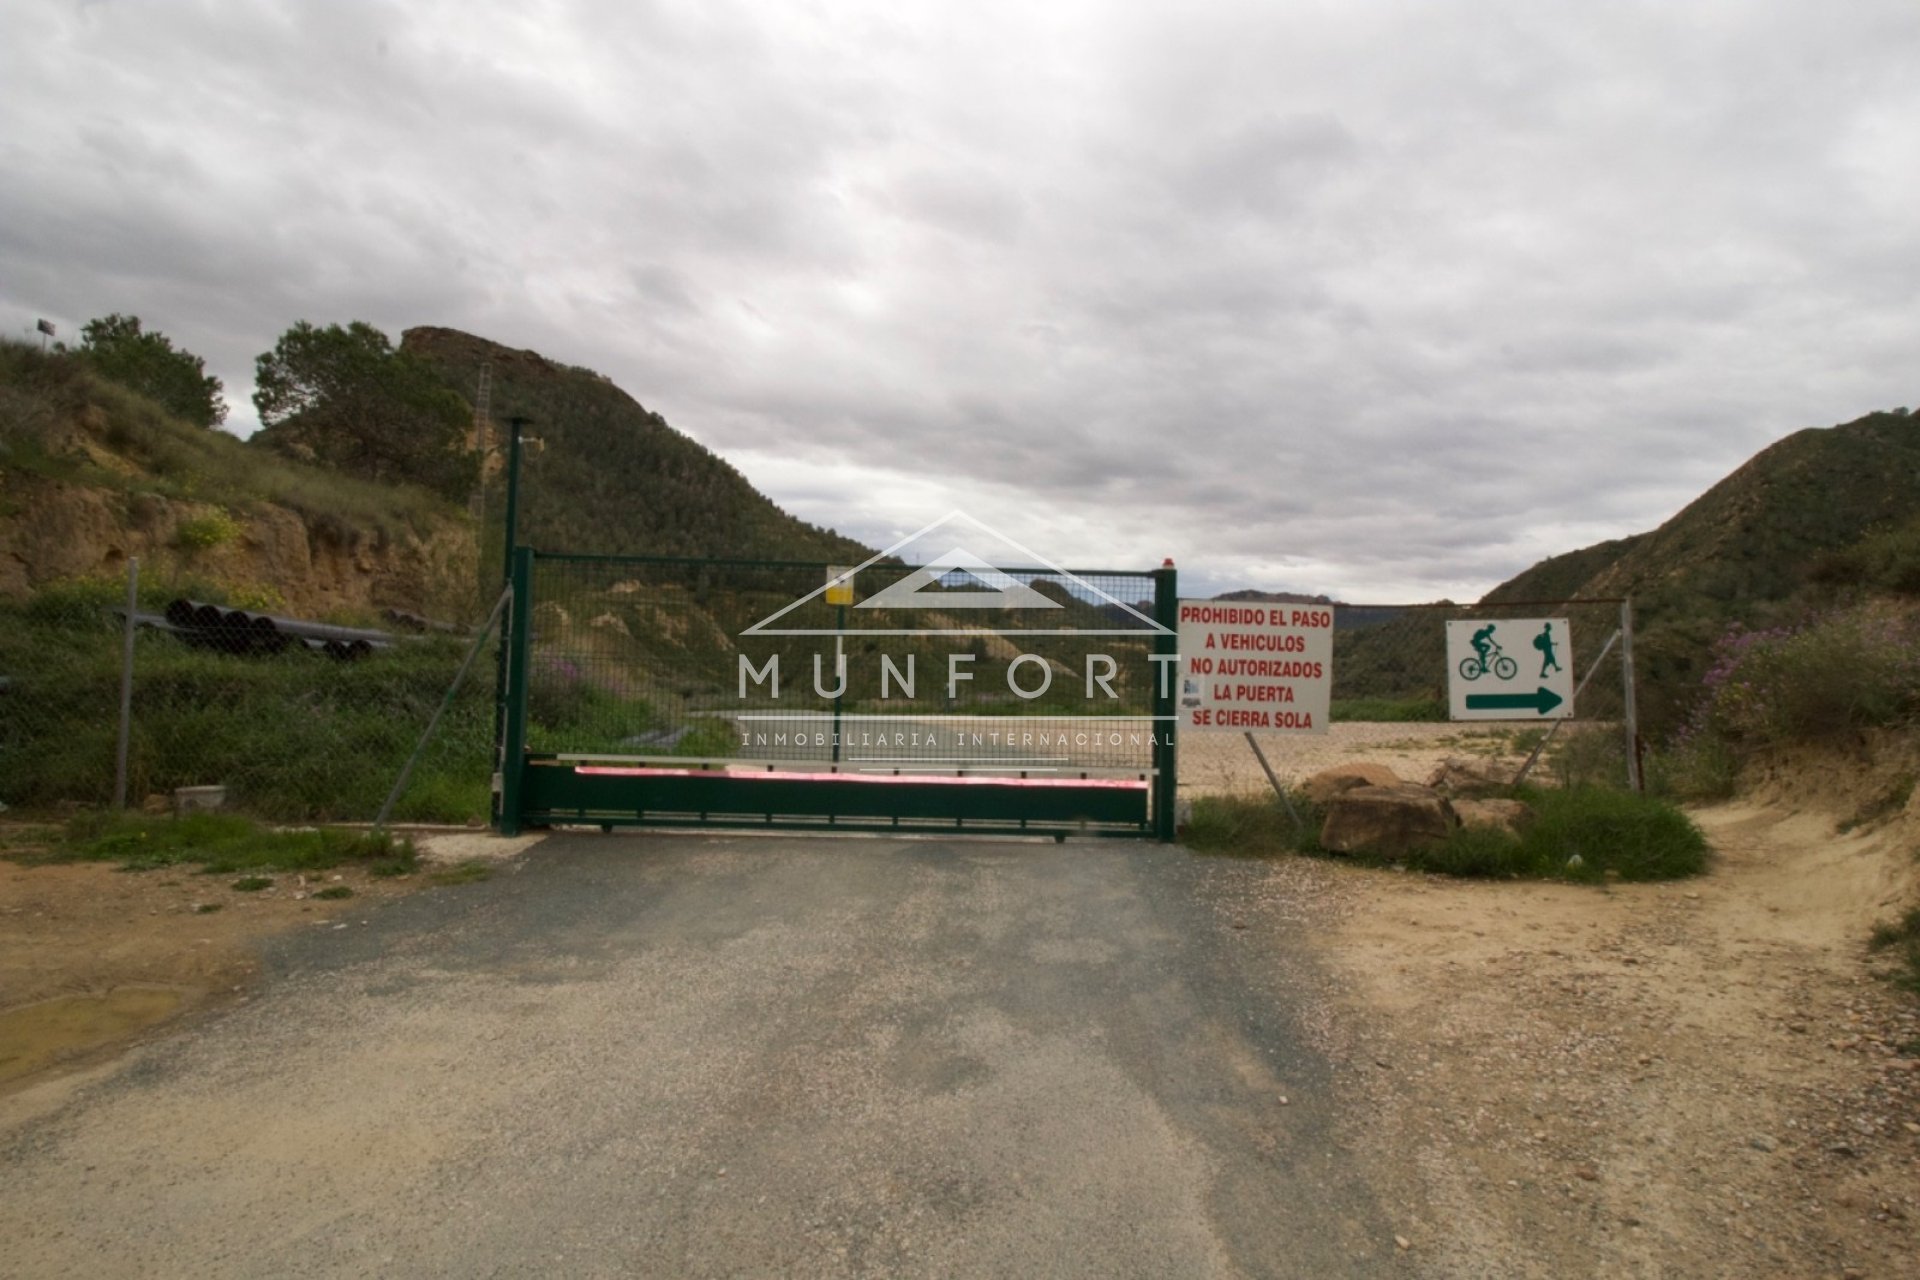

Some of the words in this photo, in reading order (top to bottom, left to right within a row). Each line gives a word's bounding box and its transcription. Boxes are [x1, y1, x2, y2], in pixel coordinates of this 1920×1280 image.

[1180, 606, 1265, 626] PROHIBIDO
[1269, 610, 1287, 626] EL
[1292, 611, 1331, 628] PASO
[1205, 633, 1216, 649] A
[1220, 633, 1305, 653] VEHICULOS
[1190, 657, 1213, 675] NO
[1217, 658, 1323, 679] AUTORIZADOS
[1213, 684, 1232, 701] LA
[1236, 684, 1295, 703] PUERTA
[1192, 709, 1212, 726] SE
[1216, 710, 1270, 728] CIERRA
[1274, 711, 1313, 729] SOLA
